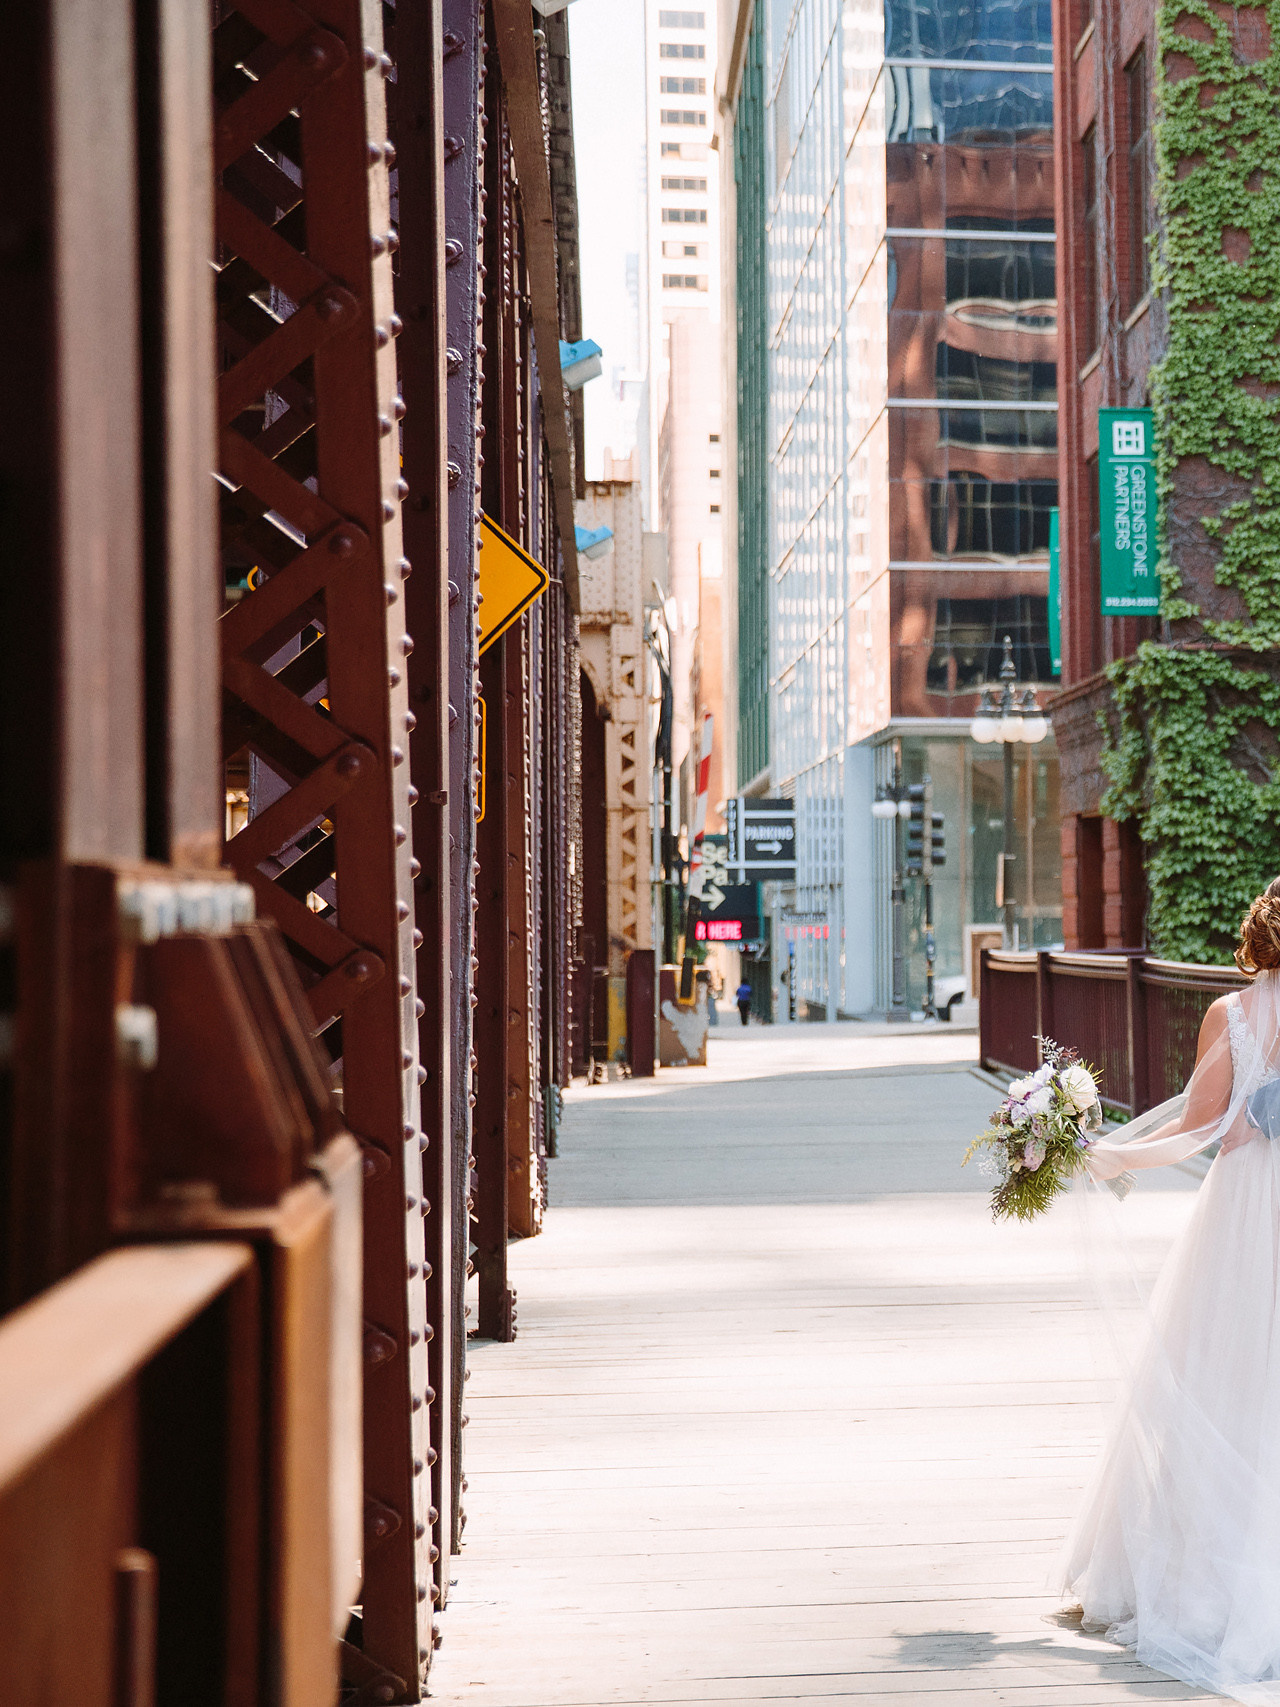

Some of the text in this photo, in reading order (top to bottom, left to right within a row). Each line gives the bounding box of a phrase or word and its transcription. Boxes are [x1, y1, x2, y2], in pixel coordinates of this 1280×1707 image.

[1113, 465, 1131, 551] PARTNERS
[1130, 464, 1148, 578] GREENSTONE
[745, 825, 794, 841] PARKING
[701, 841, 728, 865] Se
[707, 920, 742, 940] HERE
